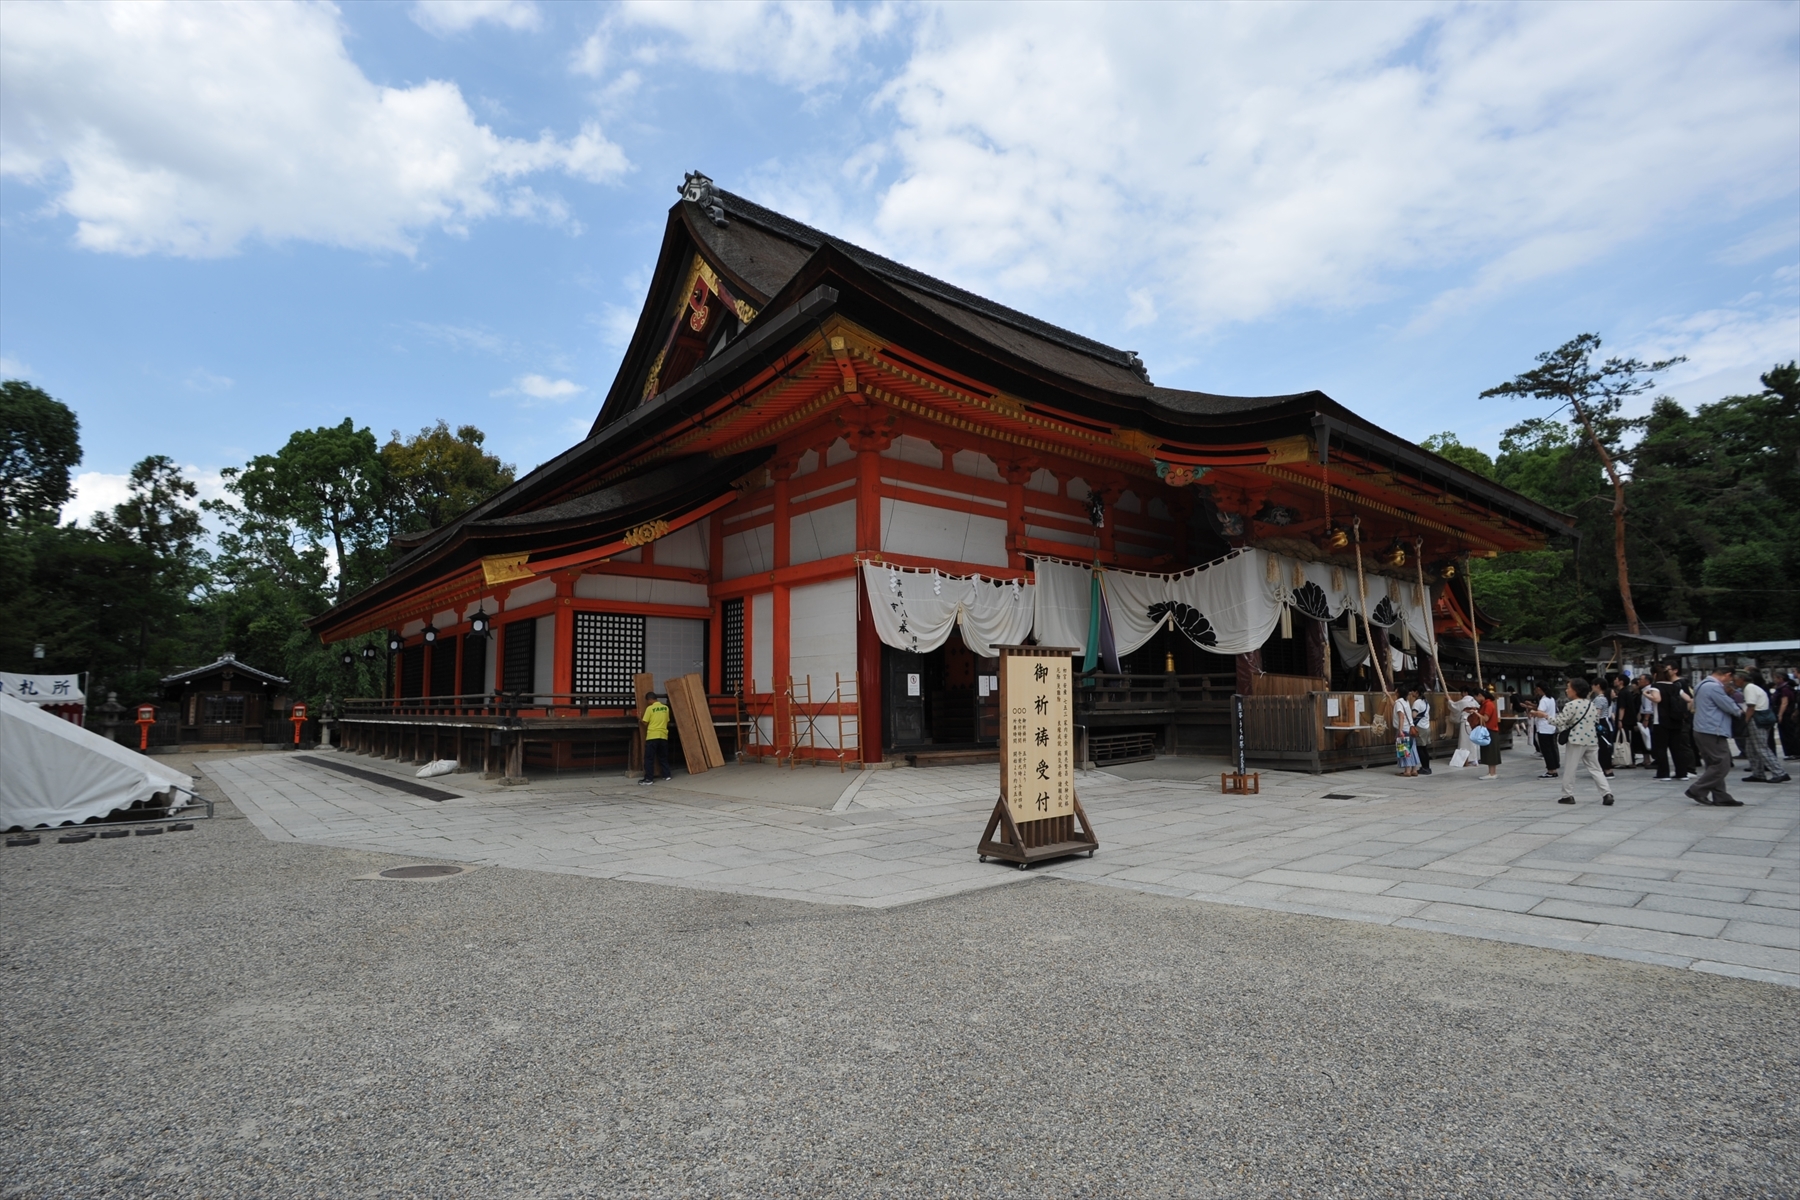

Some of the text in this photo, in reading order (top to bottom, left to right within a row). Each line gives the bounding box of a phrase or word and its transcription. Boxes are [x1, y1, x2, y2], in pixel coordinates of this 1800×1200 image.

[0, 679, 70, 695] 札所
[1033, 662, 1050, 813] 御祈祷受付
